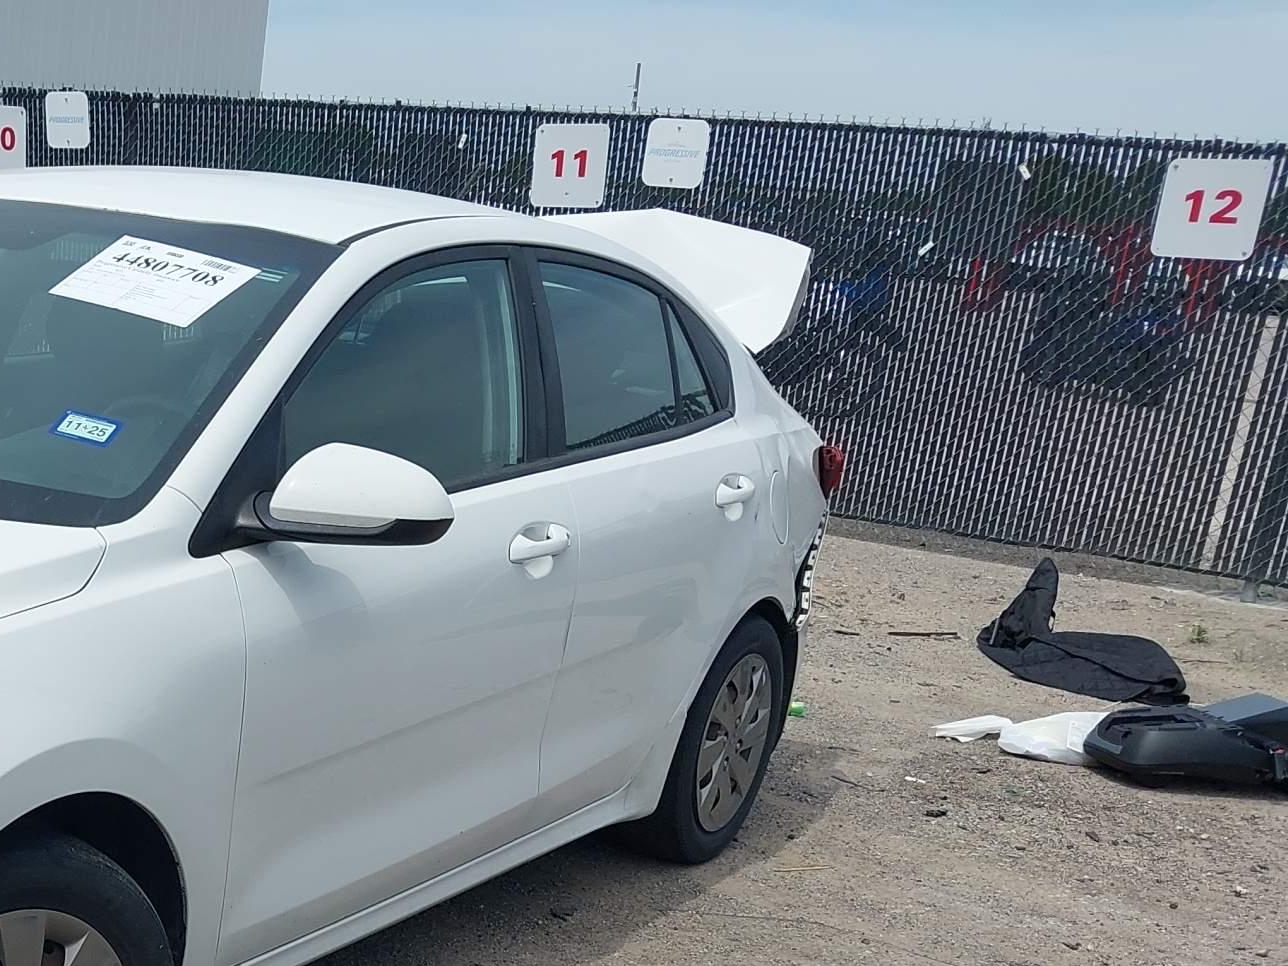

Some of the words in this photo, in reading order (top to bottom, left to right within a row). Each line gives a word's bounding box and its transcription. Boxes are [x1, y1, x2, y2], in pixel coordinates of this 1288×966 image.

[551, 150, 588, 178] 11
[1185, 189, 1242, 224] 12
[112, 252, 225, 287] 44807708
